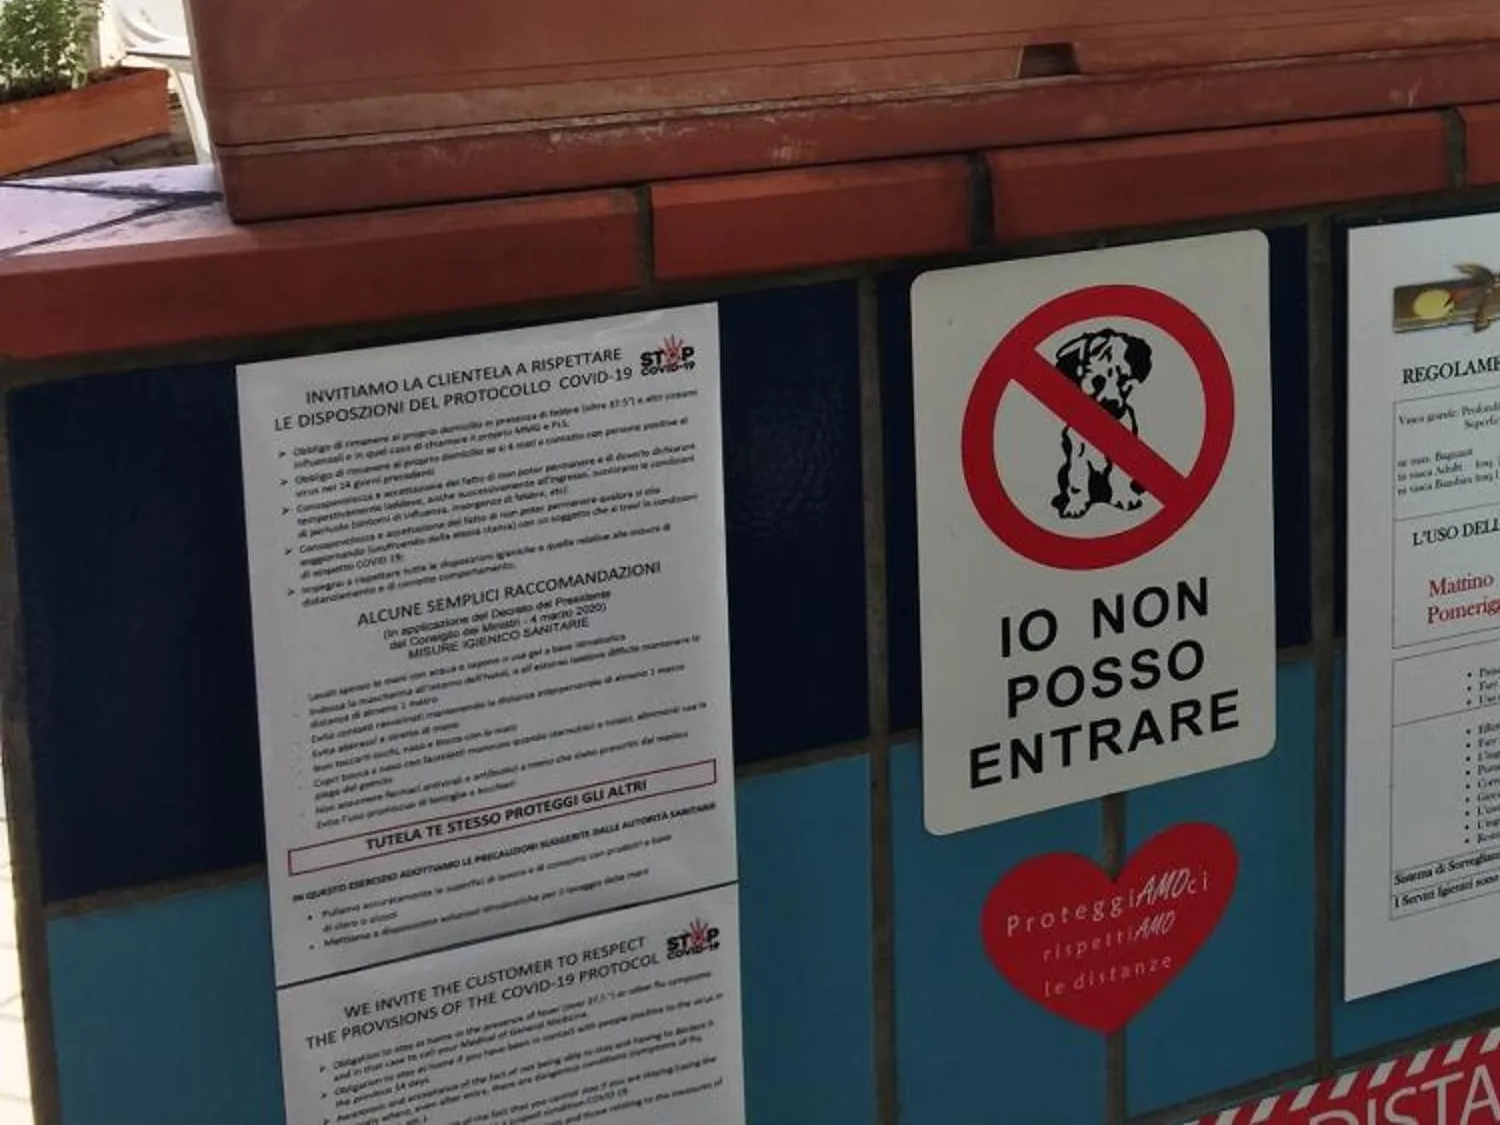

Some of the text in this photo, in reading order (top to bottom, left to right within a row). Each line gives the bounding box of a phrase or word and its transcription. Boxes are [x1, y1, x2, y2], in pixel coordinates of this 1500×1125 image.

[272, 365, 633, 432] LE DISPOSZIONI DEL PROTOCOLLO COVID-19
[305, 347, 622, 405] INVITIAMO LA CLIENTELA A RISPETTARE
[1412, 524, 1458, 547] L'USO
[356, 559, 661, 626] ALCUNE SEMPLICI RACCOMANDAZIONI
[1000, 576, 1208, 658] IO NON
[1428, 567, 1494, 599] Mattino
[1007, 639, 1204, 719] POSSO
[970, 688, 1240, 789] ENTRARE
[365, 778, 647, 851] TUTELA TE STESSO PROTEGGI GLI ALTRI
[1007, 866, 1209, 937] ProteggiAMOci
[1043, 910, 1176, 963] rispettiAMO
[305, 951, 660, 1051] THE PROVISIONS OF THE COVID-19 PROTOCOL
[343, 934, 646, 1019] WE INVITE THE CUSTOMER TO RESPECT
[1045, 954, 1173, 998] le distanze
